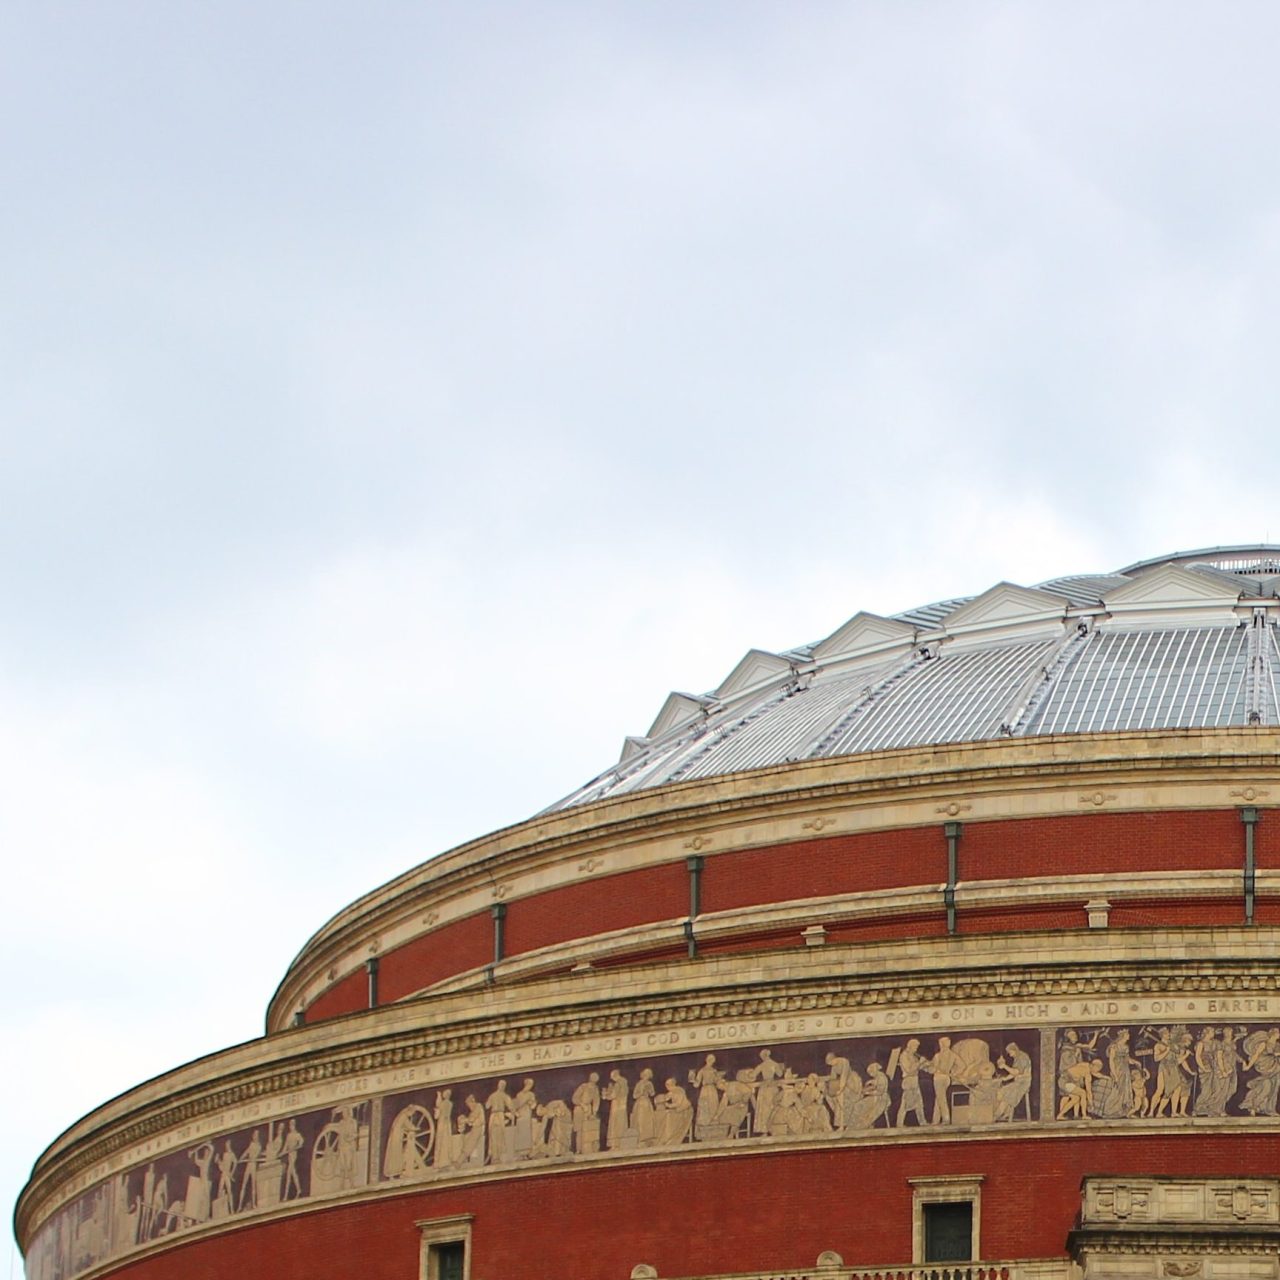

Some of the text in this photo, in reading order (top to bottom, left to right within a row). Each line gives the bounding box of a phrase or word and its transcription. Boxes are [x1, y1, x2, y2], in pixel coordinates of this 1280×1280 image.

[479, 1055, 505, 1069] THE
[533, 1044, 573, 1061] HAND
[604, 1038, 622, 1052] OF
[706, 1022, 761, 1040] GLORY
[786, 1019, 806, 1033] BE
[833, 1015, 856, 1028] TO
[951, 1007, 975, 1021] ON
[1005, 1004, 1049, 1019] HIGH
[1080, 1002, 1119, 1016] AND
[1151, 1001, 1176, 1014] ON
[1208, 1000, 1268, 1013] EARTH
